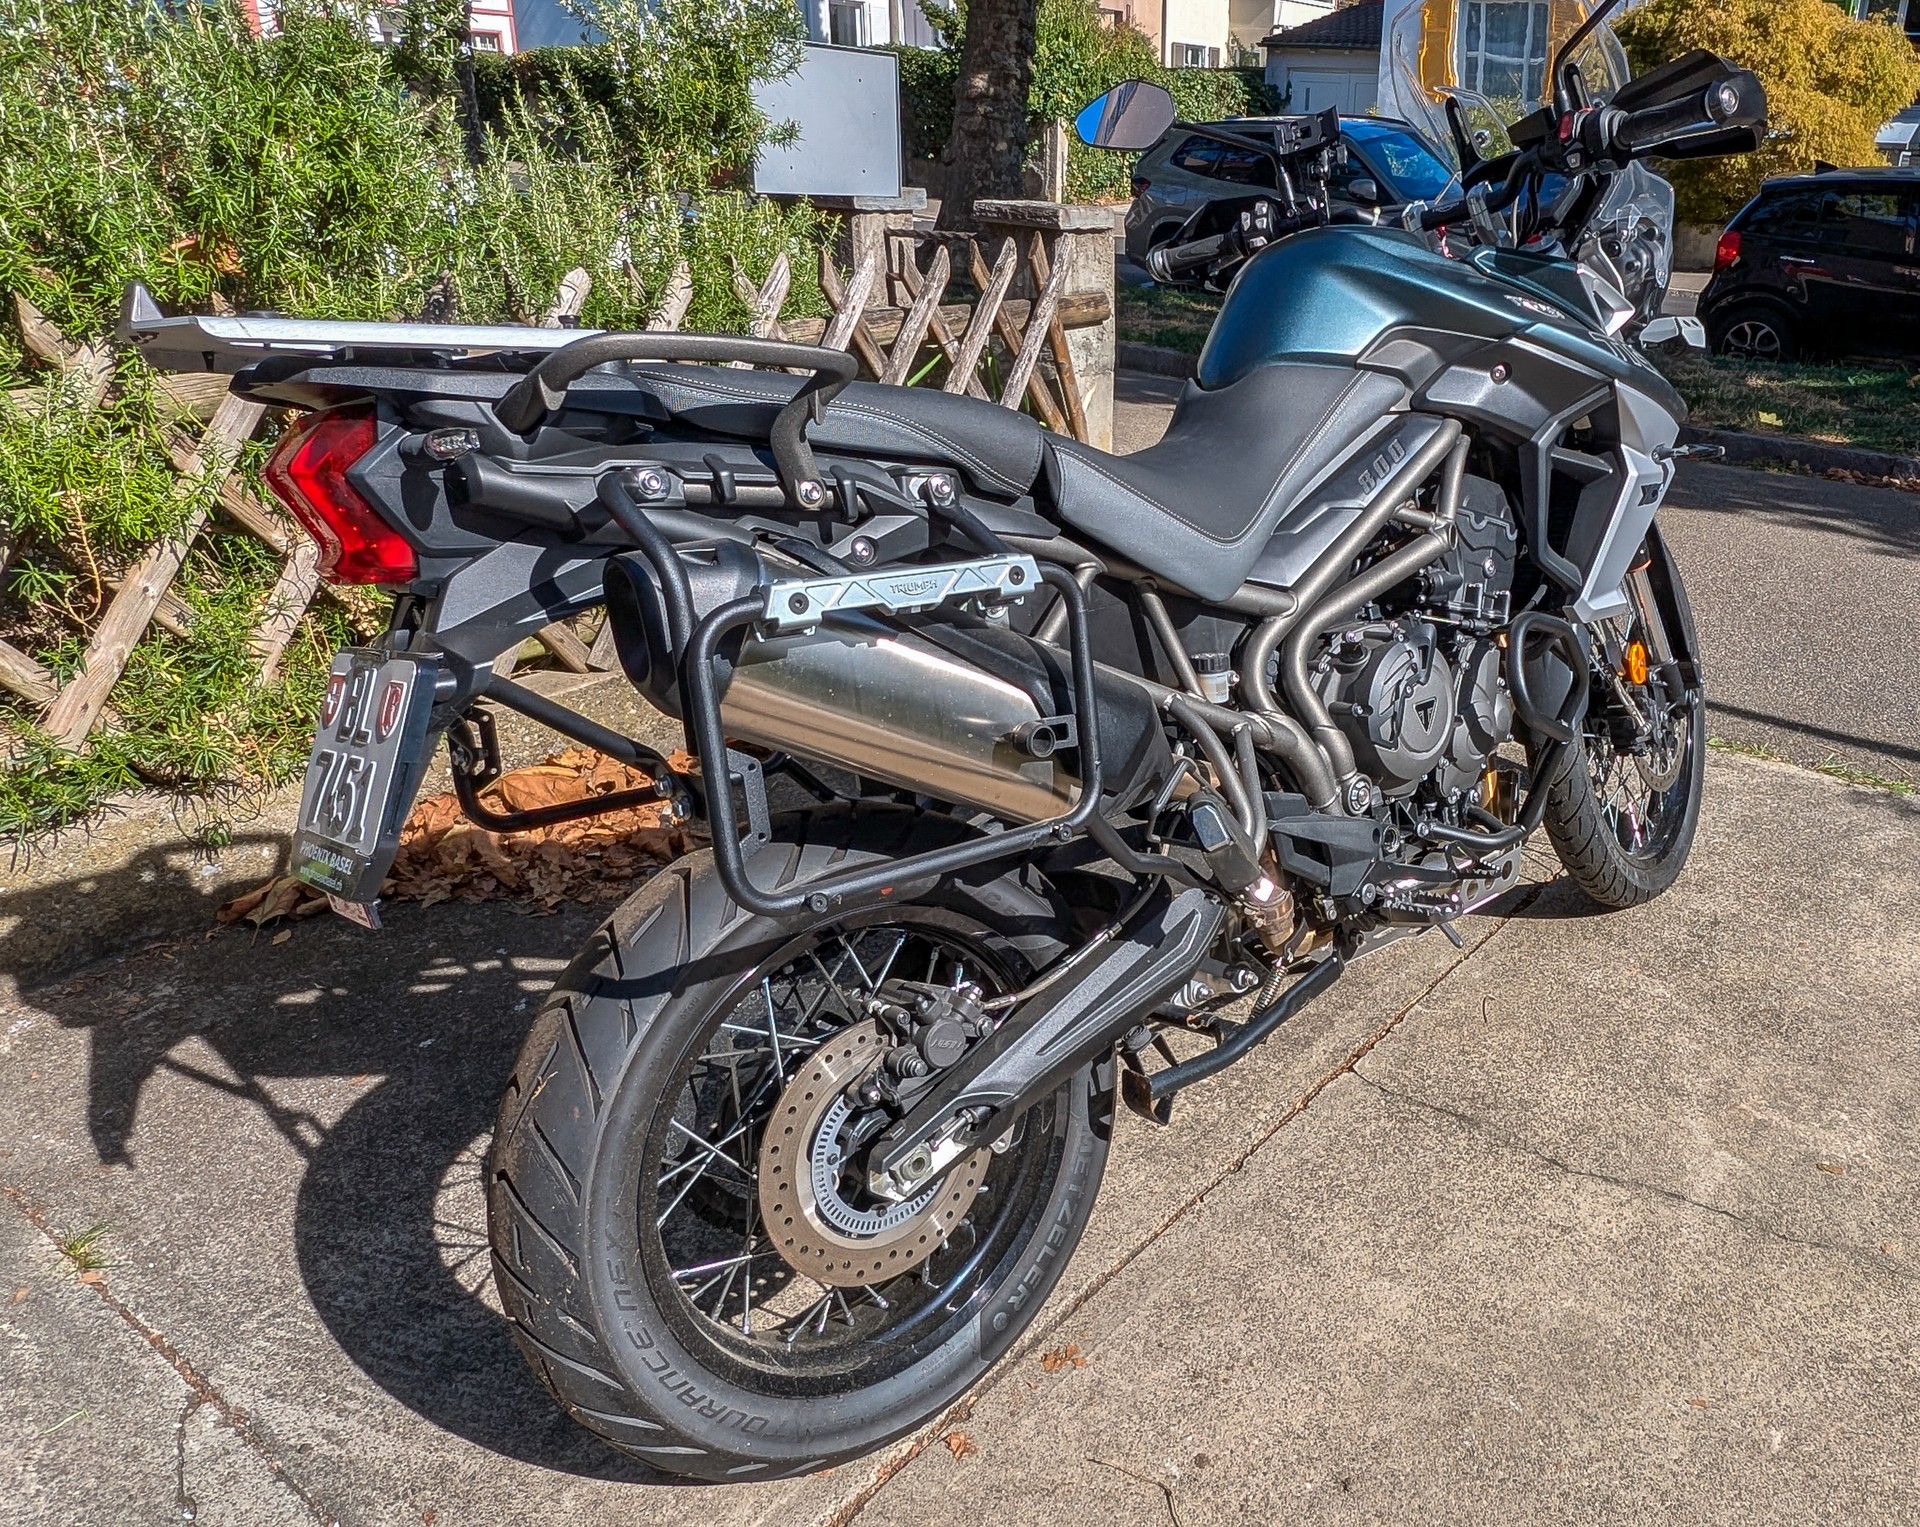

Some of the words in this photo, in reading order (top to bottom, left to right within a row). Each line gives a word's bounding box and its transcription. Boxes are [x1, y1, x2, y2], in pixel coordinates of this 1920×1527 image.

[1358, 438, 1406, 495] 800
[889, 579, 938, 596] TRIUMPH
[300, 841, 331, 865] PHOENIX
[329, 852, 354, 875] BASEL
[1008, 1125, 1095, 1311] METZELER
[626, 1326, 791, 1438] TOURANCE
